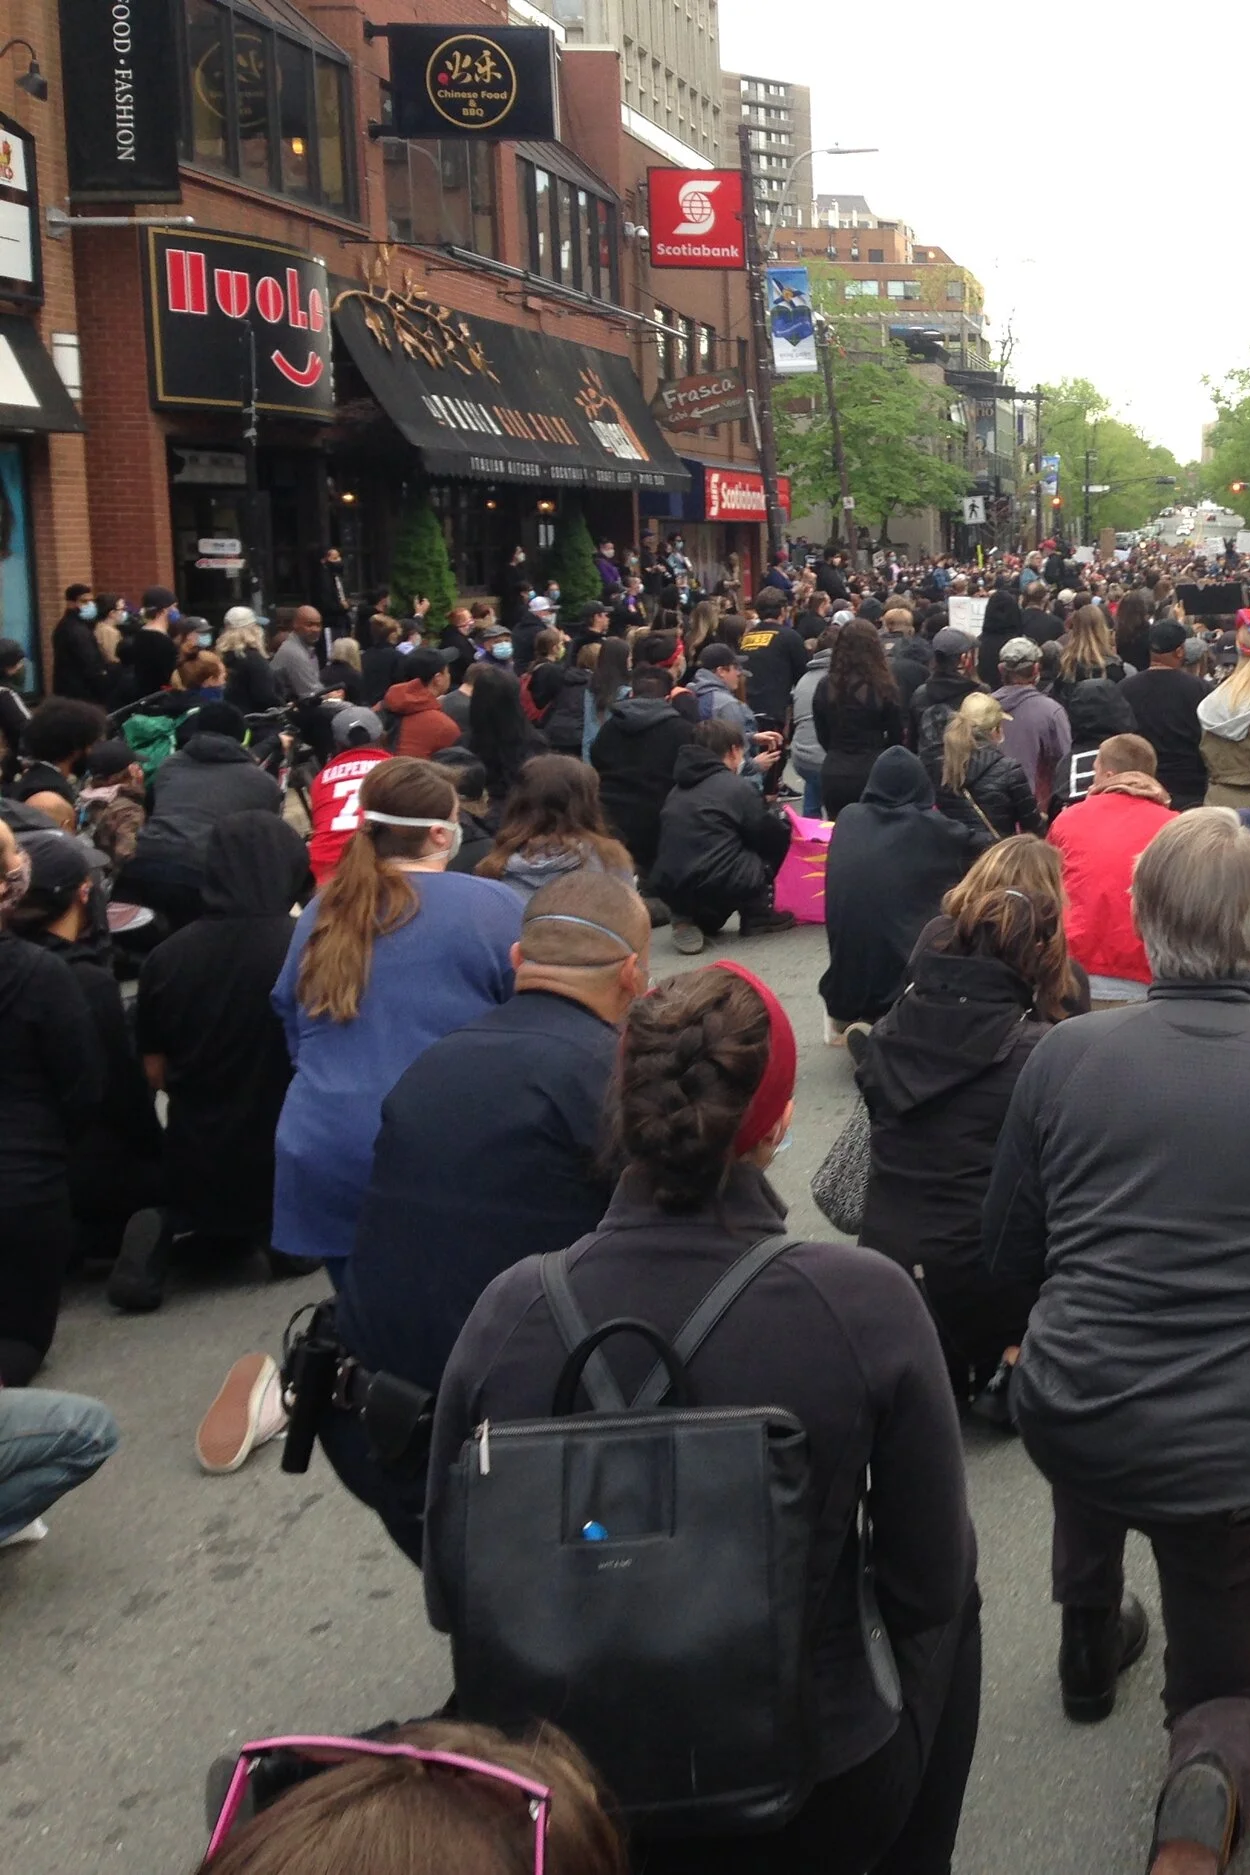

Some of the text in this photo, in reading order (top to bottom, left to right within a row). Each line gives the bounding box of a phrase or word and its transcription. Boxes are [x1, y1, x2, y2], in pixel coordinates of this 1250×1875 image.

[437, 89, 507, 100] Chinese Food
[114, 69, 136, 161] FASHION
[462, 107, 485, 117] BBQ
[656, 243, 739, 258] Scotiabank
[662, 379, 735, 409] Frasca
[330, 778, 364, 832] 7
